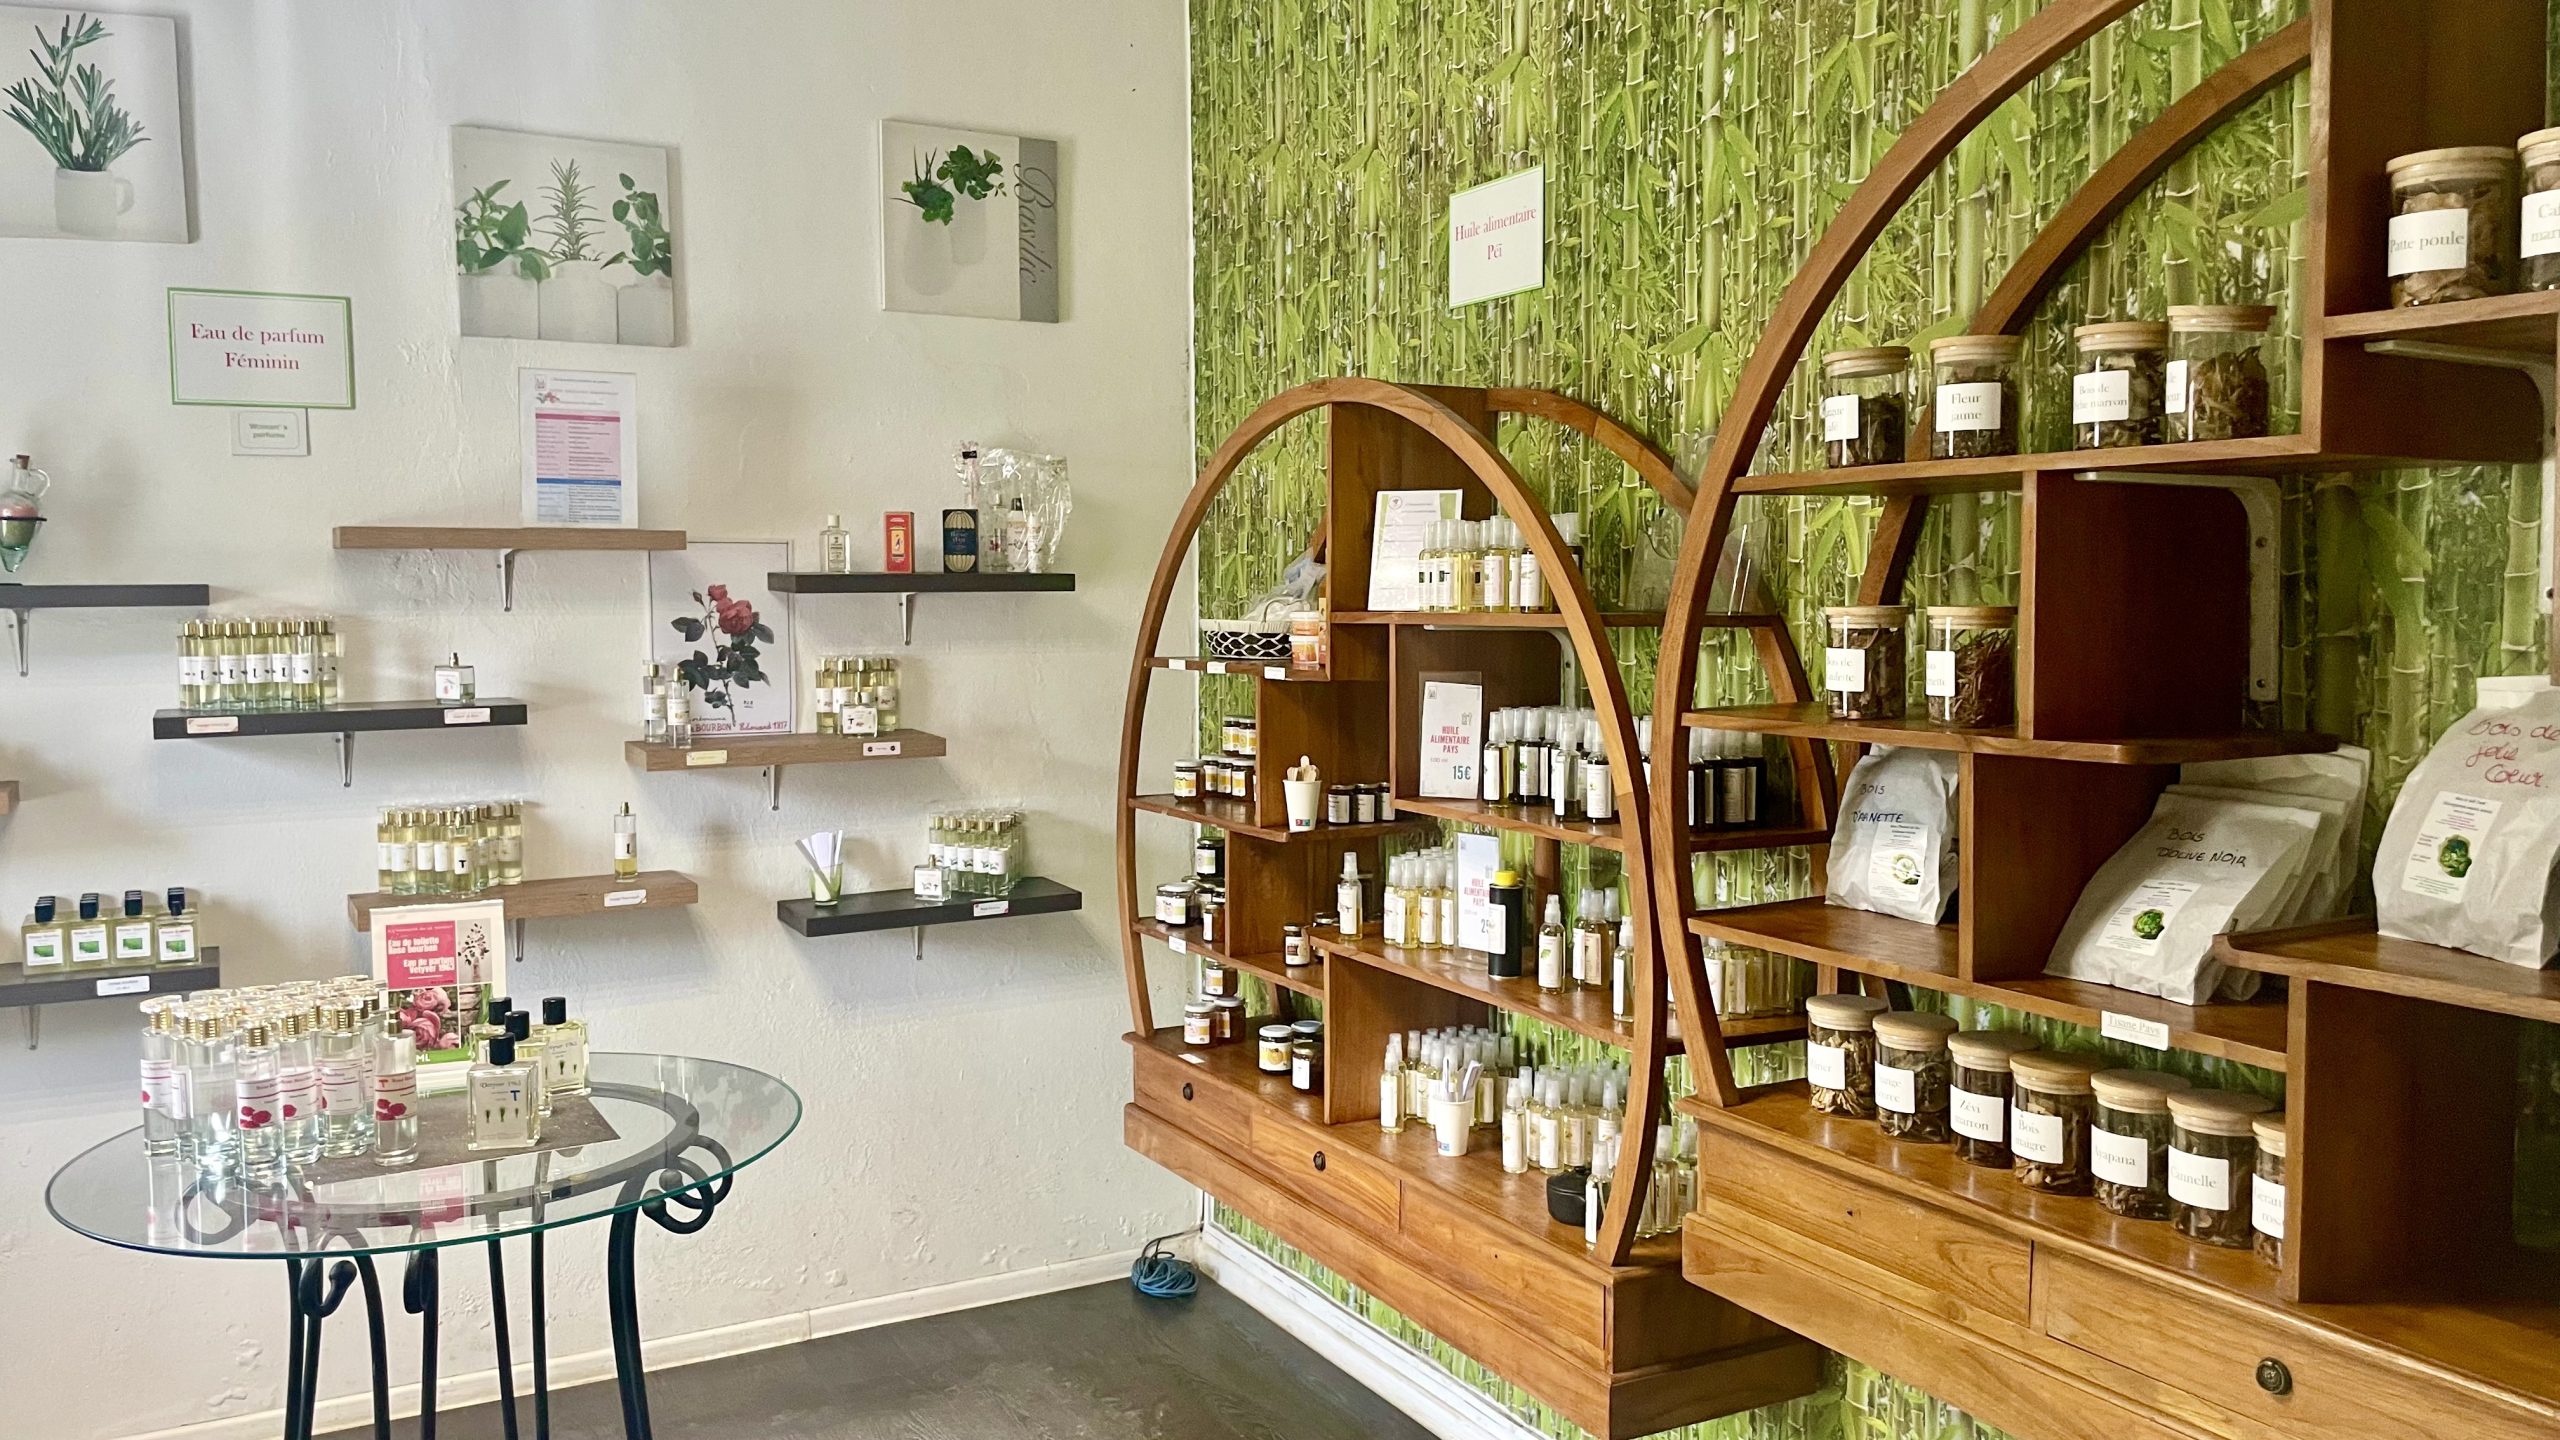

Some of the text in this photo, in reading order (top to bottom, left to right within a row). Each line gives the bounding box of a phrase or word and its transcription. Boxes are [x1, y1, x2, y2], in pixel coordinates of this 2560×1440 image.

[1013, 163, 1057, 283] Basilic
[1455, 206, 1537, 241] Huile alimentaire
[2418, 231, 2465, 251] poule
[191, 323, 325, 345] Eau de parfum
[225, 352, 300, 370] Féminin
[1951, 393, 1981, 405] Fleur
[696, 722, 732, 733] BOURBON
[1442, 726, 1459, 735] HUILE
[1430, 736, 1470, 745] ALIMENTAIRE
[1443, 745, 1459, 754] PAYS
[1452, 765, 1471, 780] 15€
[1860, 783, 1886, 795] BOIS
[510, 1090, 520, 1101] T
[1955, 1115, 1989, 1131] marron
[2018, 1118, 2040, 1134] Bois
[2015, 1136, 2047, 1152] maigre
[2171, 1166, 2217, 1188] Cannelle
